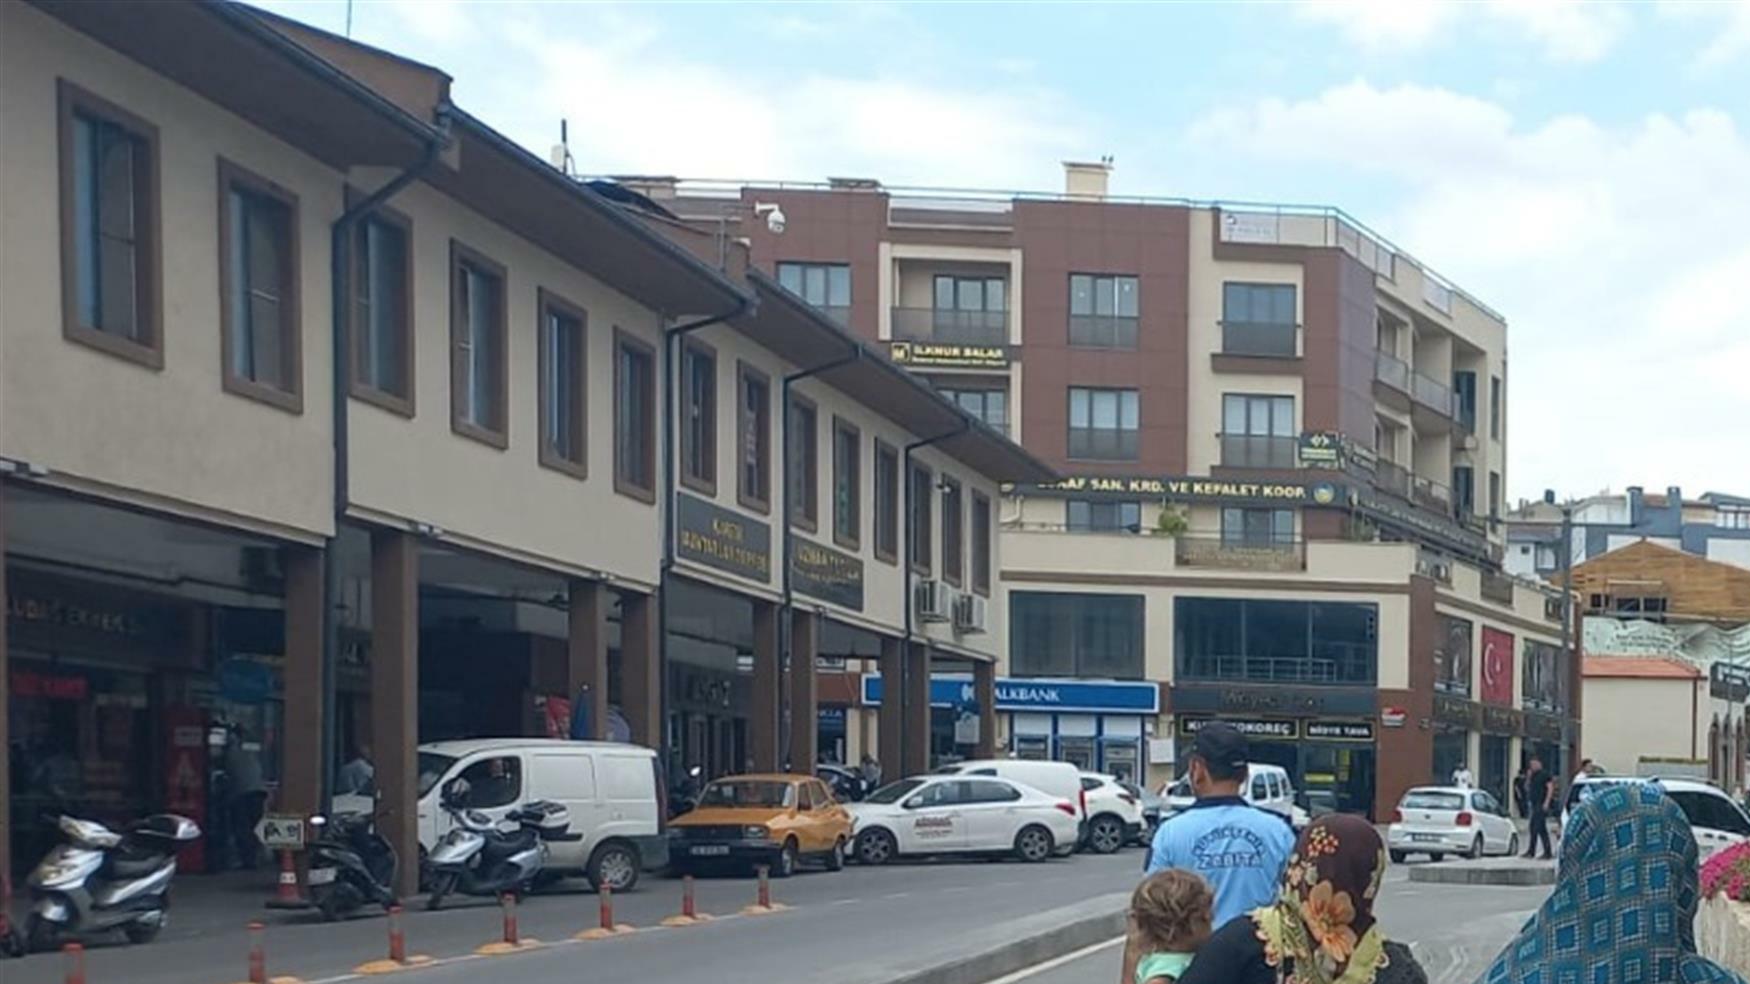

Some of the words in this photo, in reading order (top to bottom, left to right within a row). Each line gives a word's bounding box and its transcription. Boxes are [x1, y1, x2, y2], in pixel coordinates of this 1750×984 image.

[1090, 478, 1125, 491] SAN.
[1129, 480, 1165, 493] KRD.
[1168, 481, 1189, 493] VE
[1192, 482, 1260, 497] KEFALET
[1262, 485, 1306, 499] KOOP.
[994, 686, 1061, 703] ALKBANK
[1231, 721, 1291, 735] OKOREÇ
